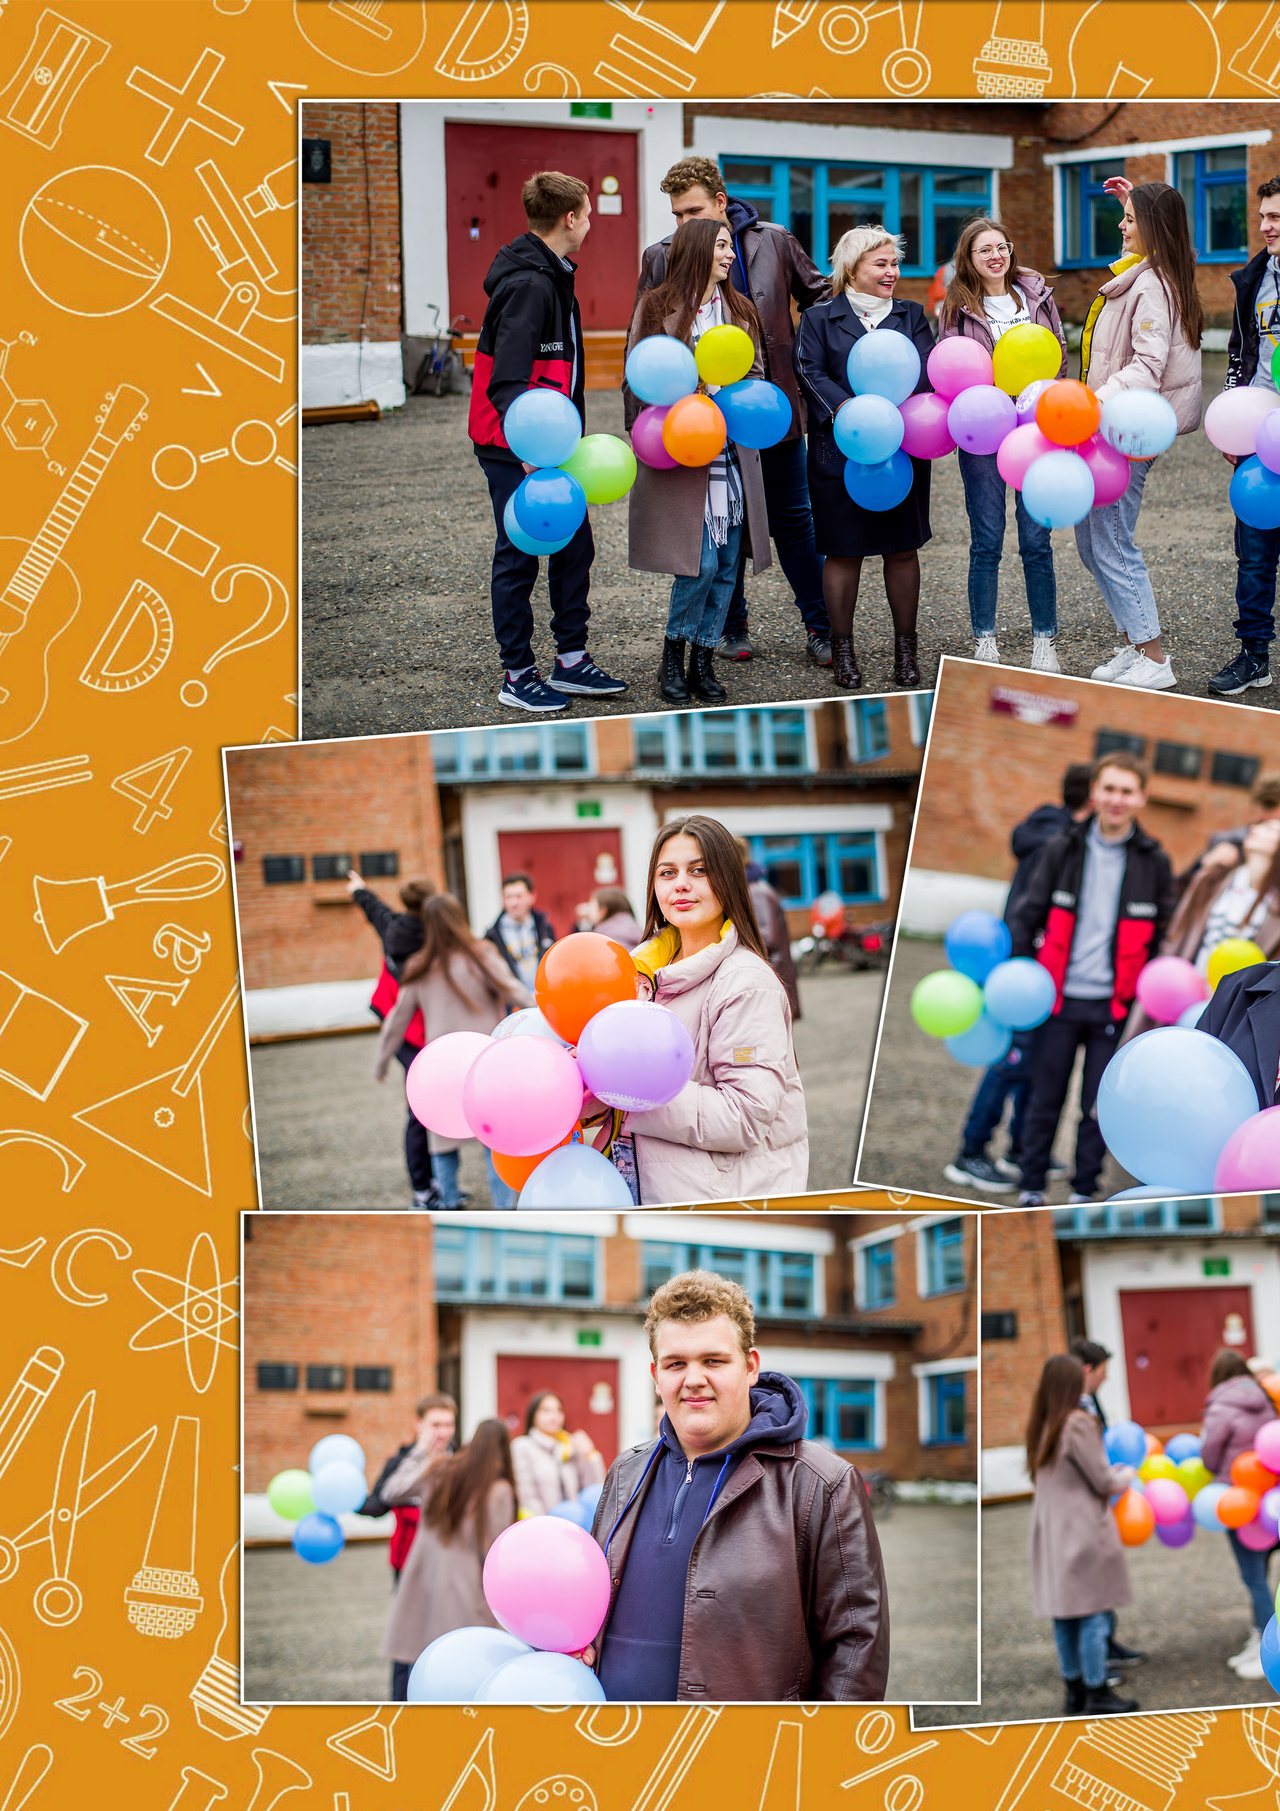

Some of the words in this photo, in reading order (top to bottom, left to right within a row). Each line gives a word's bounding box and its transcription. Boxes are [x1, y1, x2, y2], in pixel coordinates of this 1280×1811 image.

[18, 330, 38, 346] CN
[24, 417, 37, 431] H
[47, 460, 67, 477] CN
[111, 746, 192, 834] 4
[53, 1666, 170, 1759] 2+2
